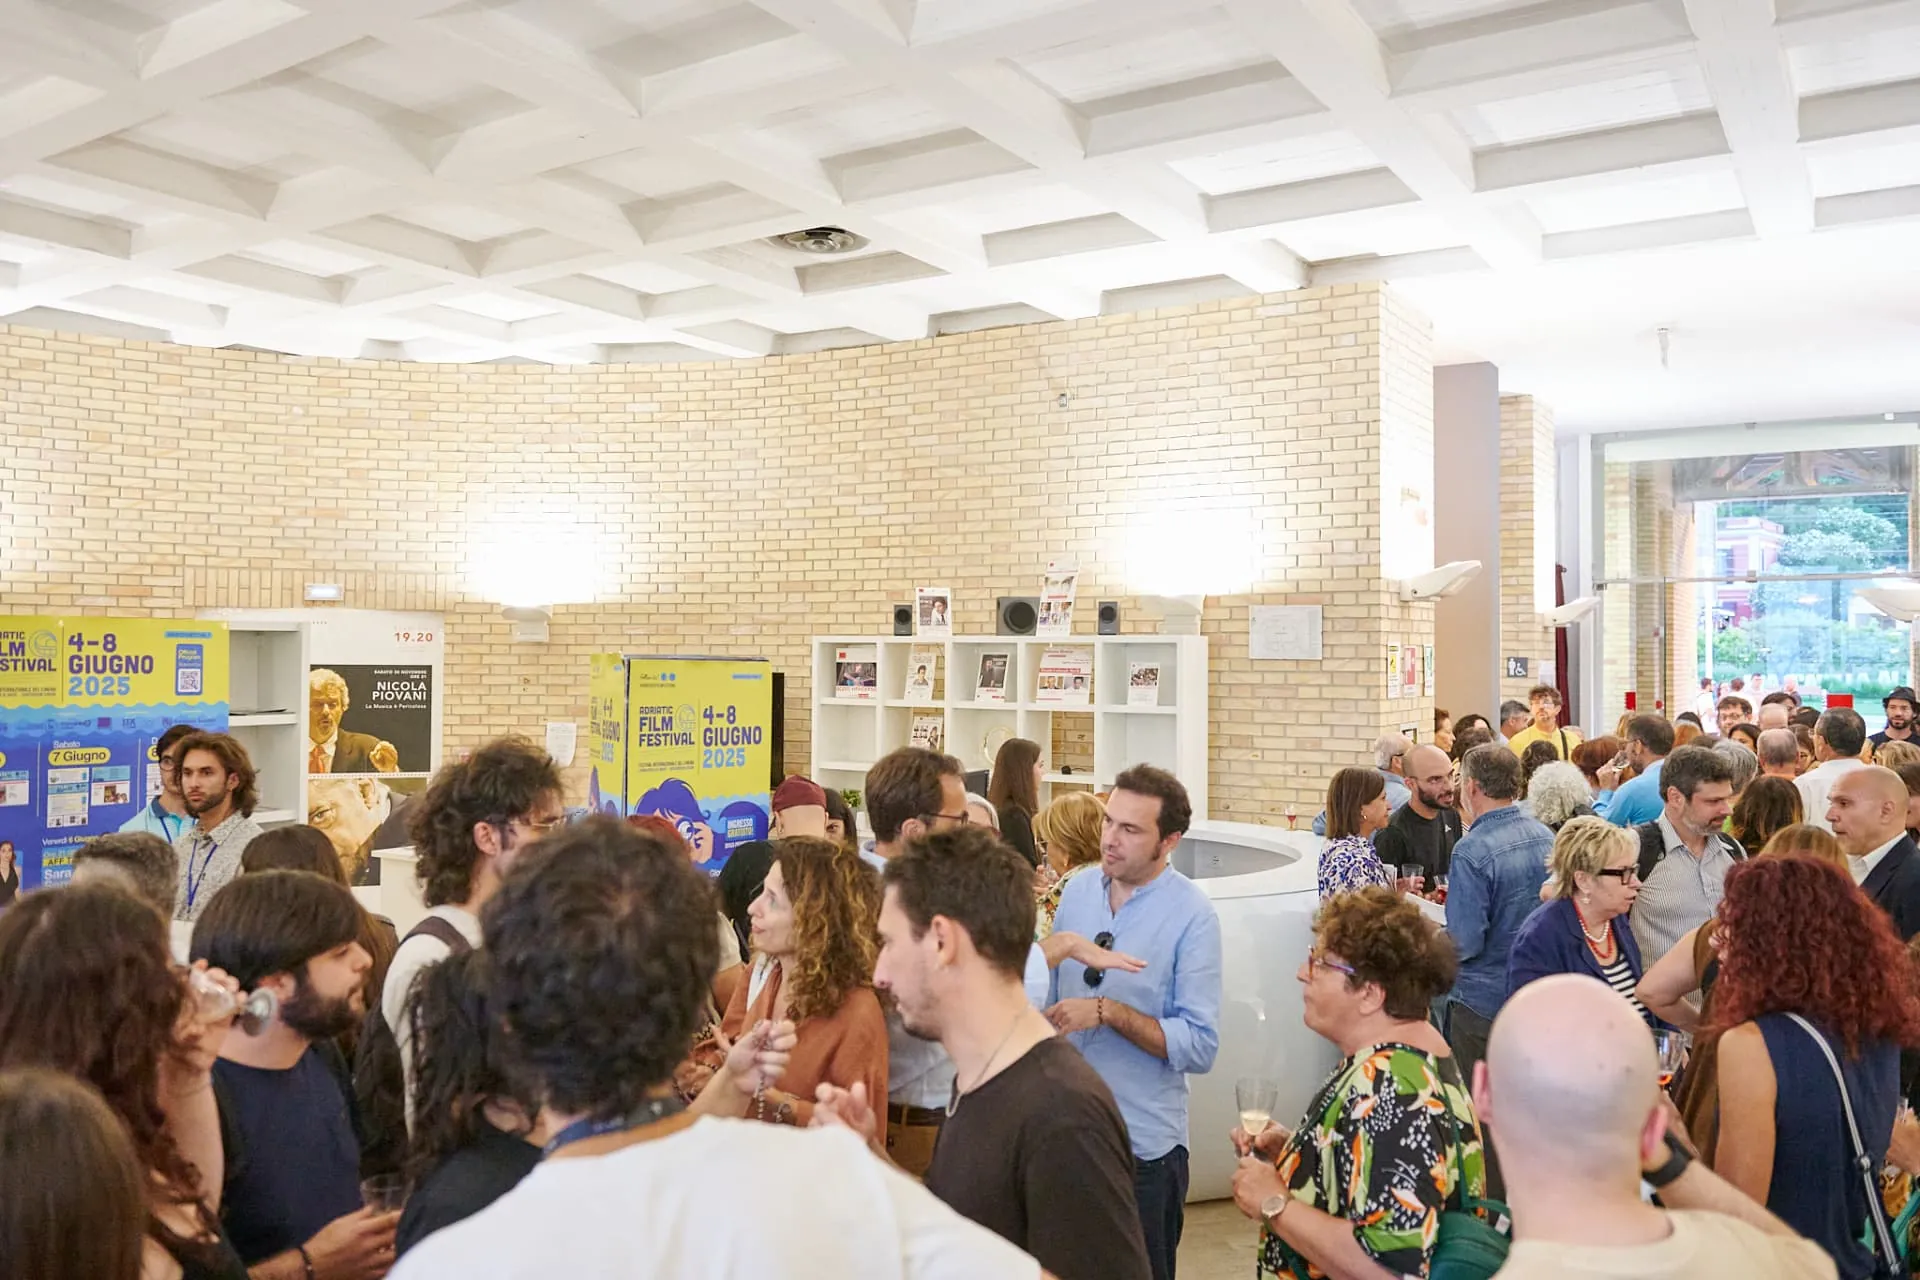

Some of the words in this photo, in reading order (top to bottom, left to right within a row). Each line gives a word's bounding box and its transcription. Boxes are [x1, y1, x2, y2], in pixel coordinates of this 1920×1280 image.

[0, 631, 25, 640] IATIC
[68, 633, 117, 652] 4-8
[395, 632, 433, 642] 19.20
[0, 641, 25, 656] LM
[0, 658, 57, 672] STIVAL
[68, 655, 154, 675] GIUGNO
[68, 677, 131, 696] 2025
[377, 681, 427, 691] NICOLA
[372, 691, 427, 701] PIOVANI
[640, 706, 673, 714] ADRIATIC
[703, 705, 736, 725] 4-8
[640, 716, 673, 732] FILM
[639, 732, 695, 747] FESTIVAL
[703, 726, 762, 747] GIUGNO
[53, 740, 80, 748] Sabato
[53, 752, 61, 762] 7
[63, 751, 106, 763] Giugno
[703, 747, 745, 768] 2025
[74, 835, 99, 844] Giugn
